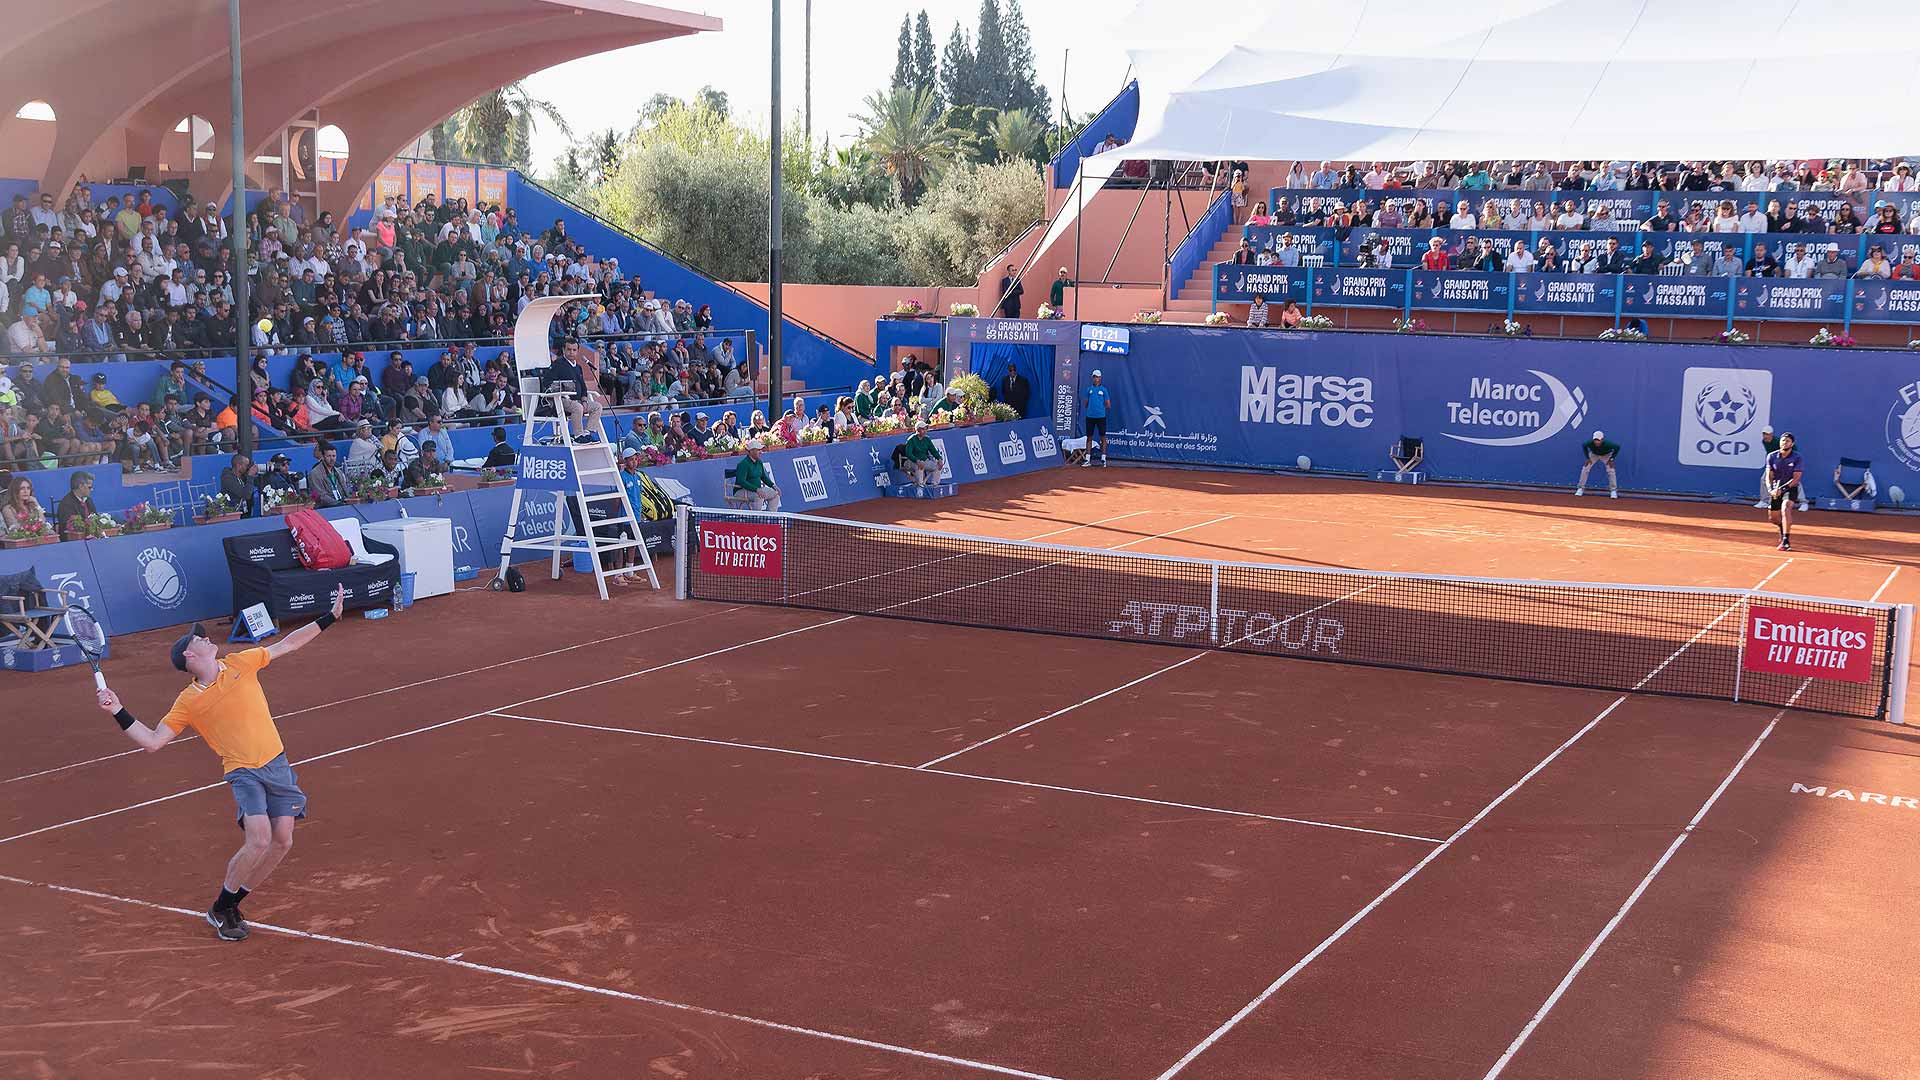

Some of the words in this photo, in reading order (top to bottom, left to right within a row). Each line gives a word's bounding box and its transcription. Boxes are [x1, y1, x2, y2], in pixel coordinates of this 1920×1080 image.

[1615, 199, 1633, 209] PRIX
[1301, 235, 1316, 246] PRIX
[1395, 237, 1411, 247] PRIX
[1494, 239, 1512, 249] PRIX
[1247, 274, 1272, 284] GRAND
[1272, 274, 1288, 284] PRIX
[1343, 276, 1369, 287] GRAND
[1370, 277, 1386, 288] PRIX
[1444, 279, 1470, 289] GRAND
[1471, 280, 1488, 290] PRIX
[1246, 283, 1279, 294] HASSAN
[1282, 284, 1288, 294] II
[1342, 286, 1377, 297] HASSAN
[1380, 287, 1386, 297] II
[1548, 282, 1576, 292] GRAND
[1577, 283, 1595, 293] PRIX
[1656, 285, 1686, 295] GRAND
[1686, 286, 1706, 296] PRIX
[1771, 286, 1801, 298] GRAND
[1802, 288, 1823, 298] PRIX
[1443, 289, 1480, 299] HASSAN
[1482, 290, 1489, 300] II
[1547, 292, 1585, 302] HASSAN
[1588, 293, 1595, 303] II
[1656, 295, 1693, 306] HASSAN
[1698, 296, 1706, 306] II
[1770, 297, 1812, 308] HASSAN
[1814, 298, 1822, 309] II
[998, 321, 1022, 331] GRAND
[1023, 322, 1039, 332] PRIX
[998, 331, 1030, 341] HASSAN
[1032, 332, 1039, 341] II
[1091, 328, 1118, 340] 01:21
[1083, 340, 1106, 352] 167
[1241, 366, 1374, 403] Marsa
[1470, 377, 1541, 401] Maroc
[1056, 395, 1066, 423] HASSAN
[1064, 395, 1073, 416] GRAND
[1239, 393, 1373, 428] Maroc
[1447, 402, 1540, 427] Telecom
[1001, 441, 1024, 458] MDJS
[1033, 438, 1054, 452] MDJS
[1138, 439, 1145, 447] la
[1146, 440, 1174, 448] Jeunesse
[1183, 442, 1196, 450] des
[1196, 443, 1217, 452] Sports
[1696, 439, 1750, 456] OCP
[523, 456, 567, 470] Marsa
[523, 467, 567, 480] Maroc
[801, 480, 825, 499] RADIO
[703, 530, 777, 552] Emirates
[136, 546, 177, 567] FRMT
[715, 551, 730, 566] FLY
[732, 552, 766, 569] BETTER
[1103, 600, 1210, 638] ATP
[1218, 608, 1346, 654] TOUR
[1753, 617, 1867, 650] Emirates
[1768, 643, 1793, 663] FLY
[1795, 646, 1849, 669] BETTER
[1790, 782, 1920, 809] MARR
